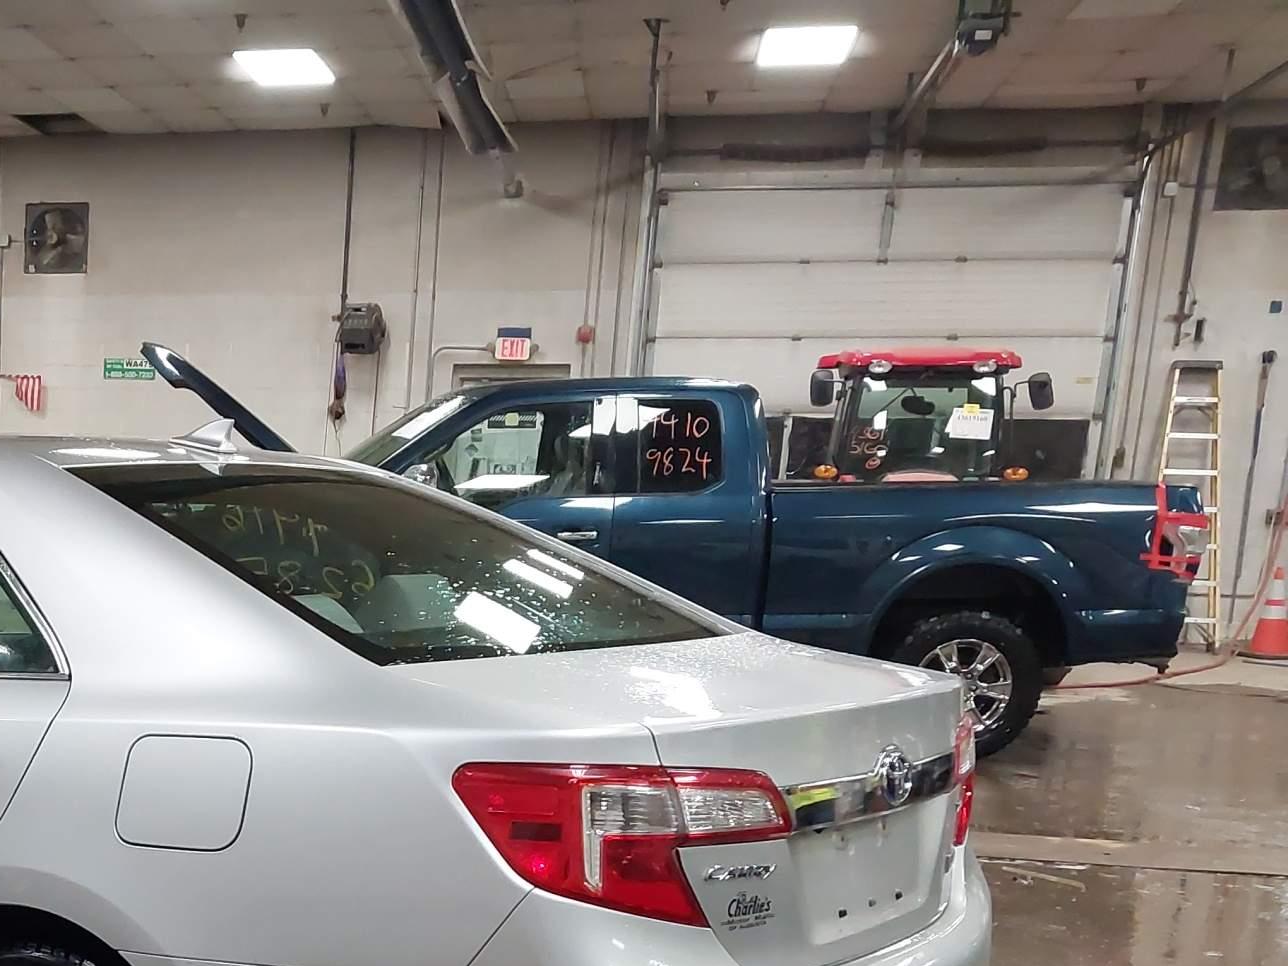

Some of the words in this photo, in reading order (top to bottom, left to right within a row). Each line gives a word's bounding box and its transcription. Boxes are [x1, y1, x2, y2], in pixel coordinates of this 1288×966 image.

[501, 338, 527, 358] EXIT
[646, 446, 713, 480] 9824
[727, 896, 772, 918] Charlie's
